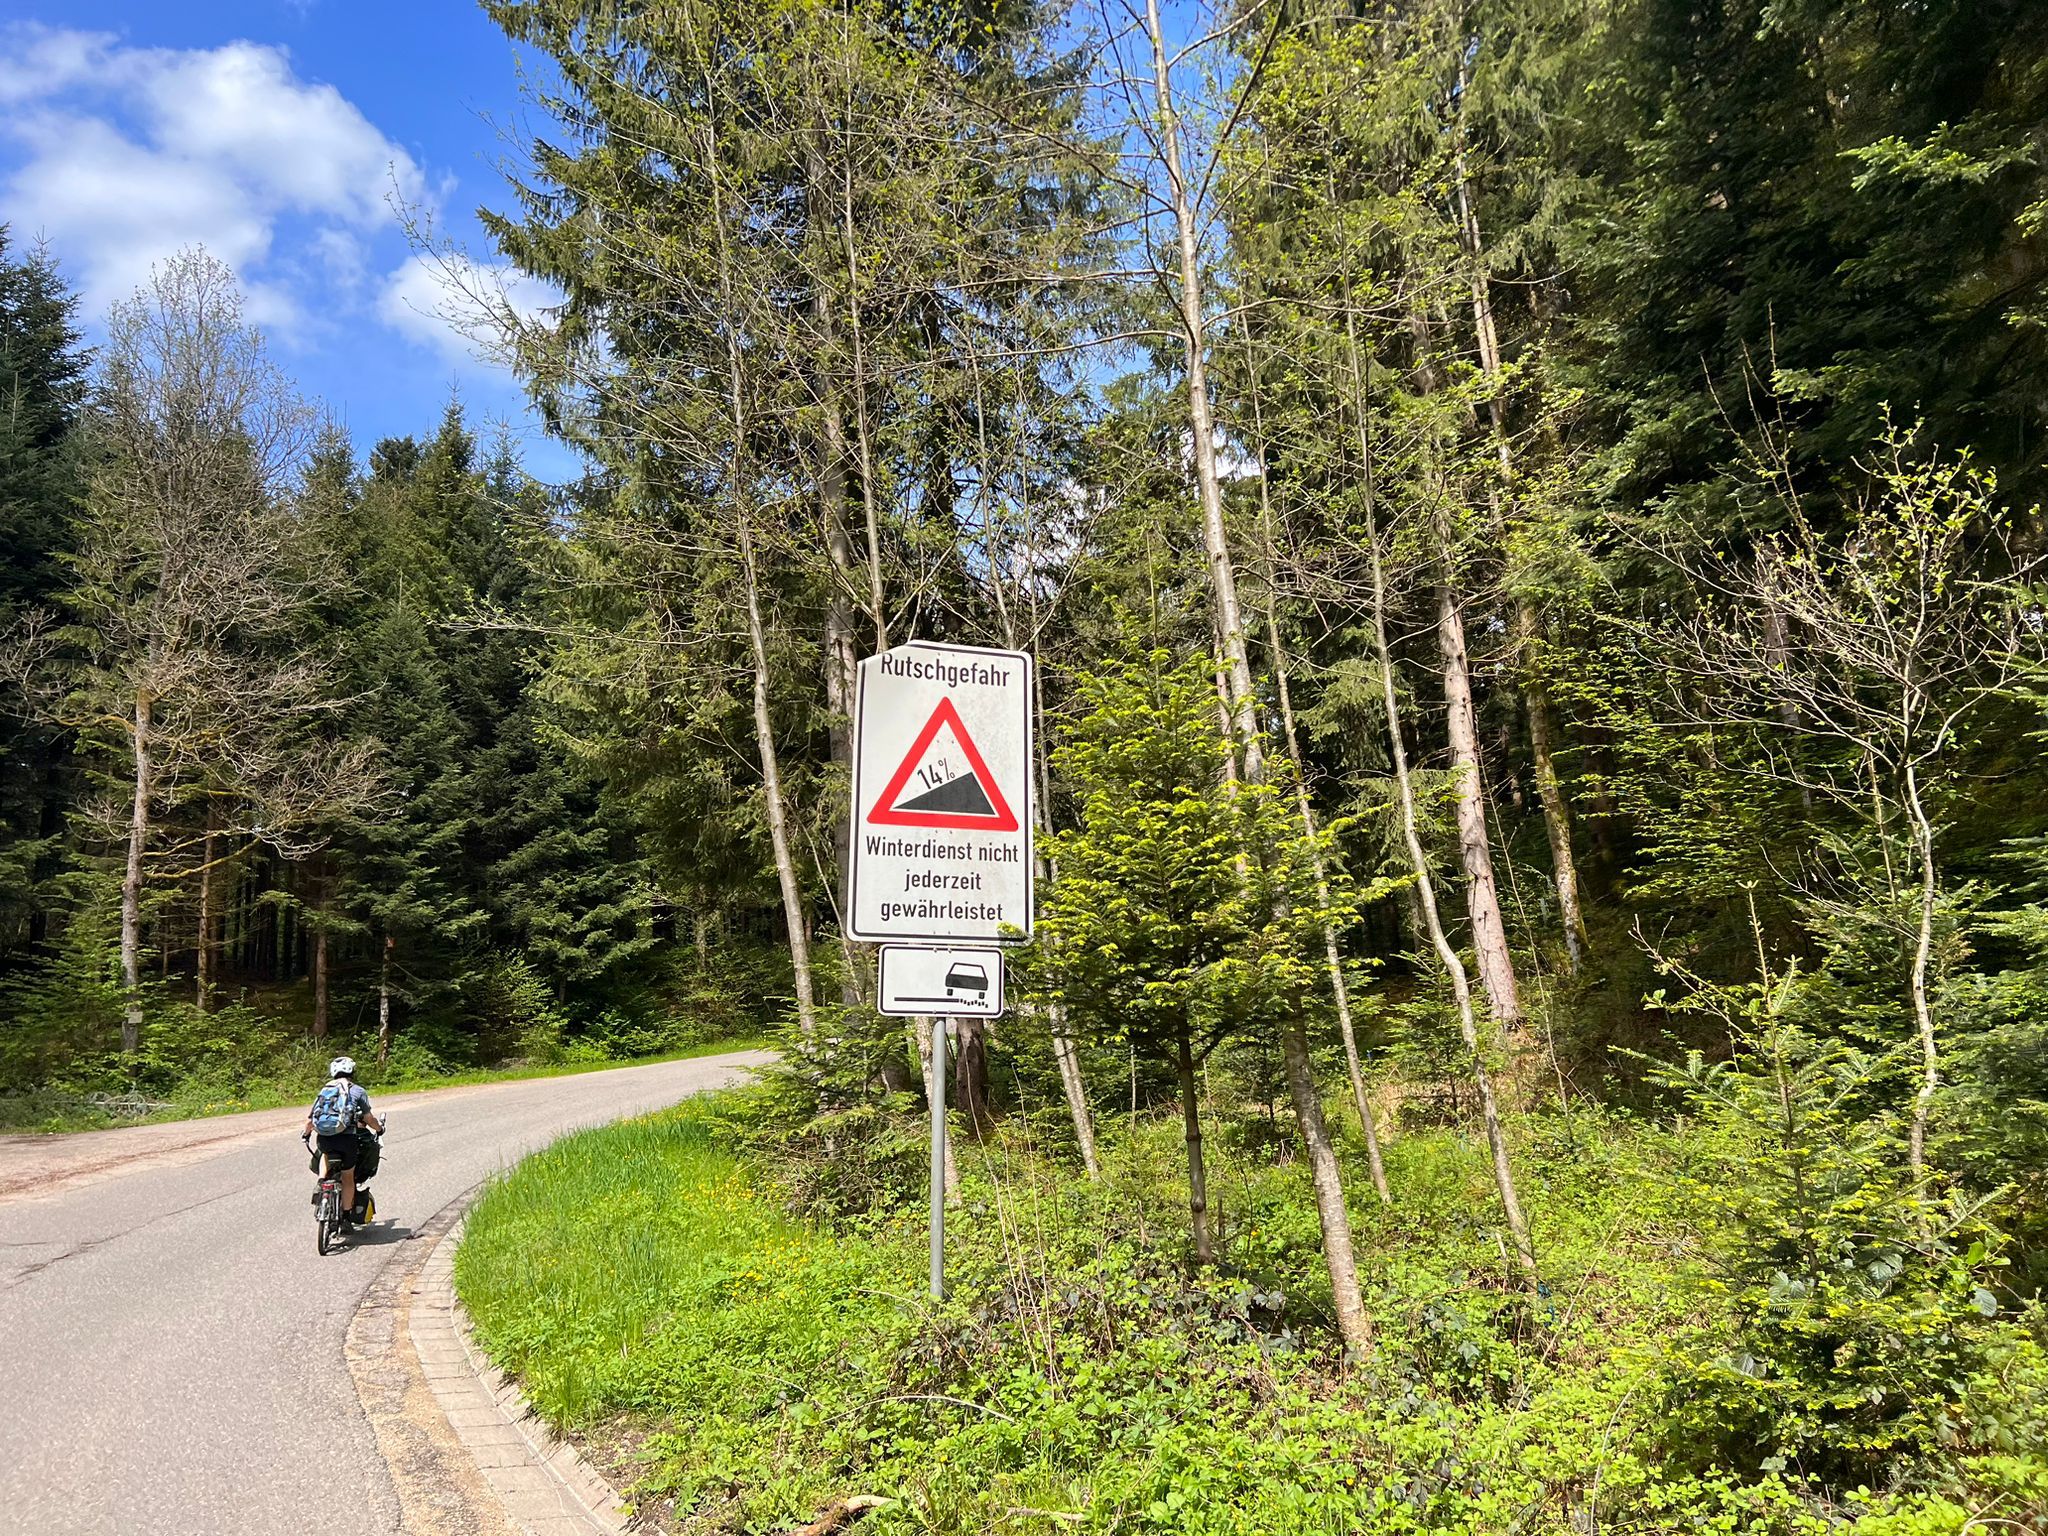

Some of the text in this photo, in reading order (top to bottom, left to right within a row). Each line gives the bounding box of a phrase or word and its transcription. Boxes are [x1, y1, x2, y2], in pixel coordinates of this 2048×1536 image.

[881, 653, 1010, 688] Rutschgefahr
[917, 757, 956, 790] 14%
[866, 835, 1019, 862] Winterdienst nicht
[904, 868, 982, 892] jederzeit
[880, 899, 1003, 921] gewährleistet
